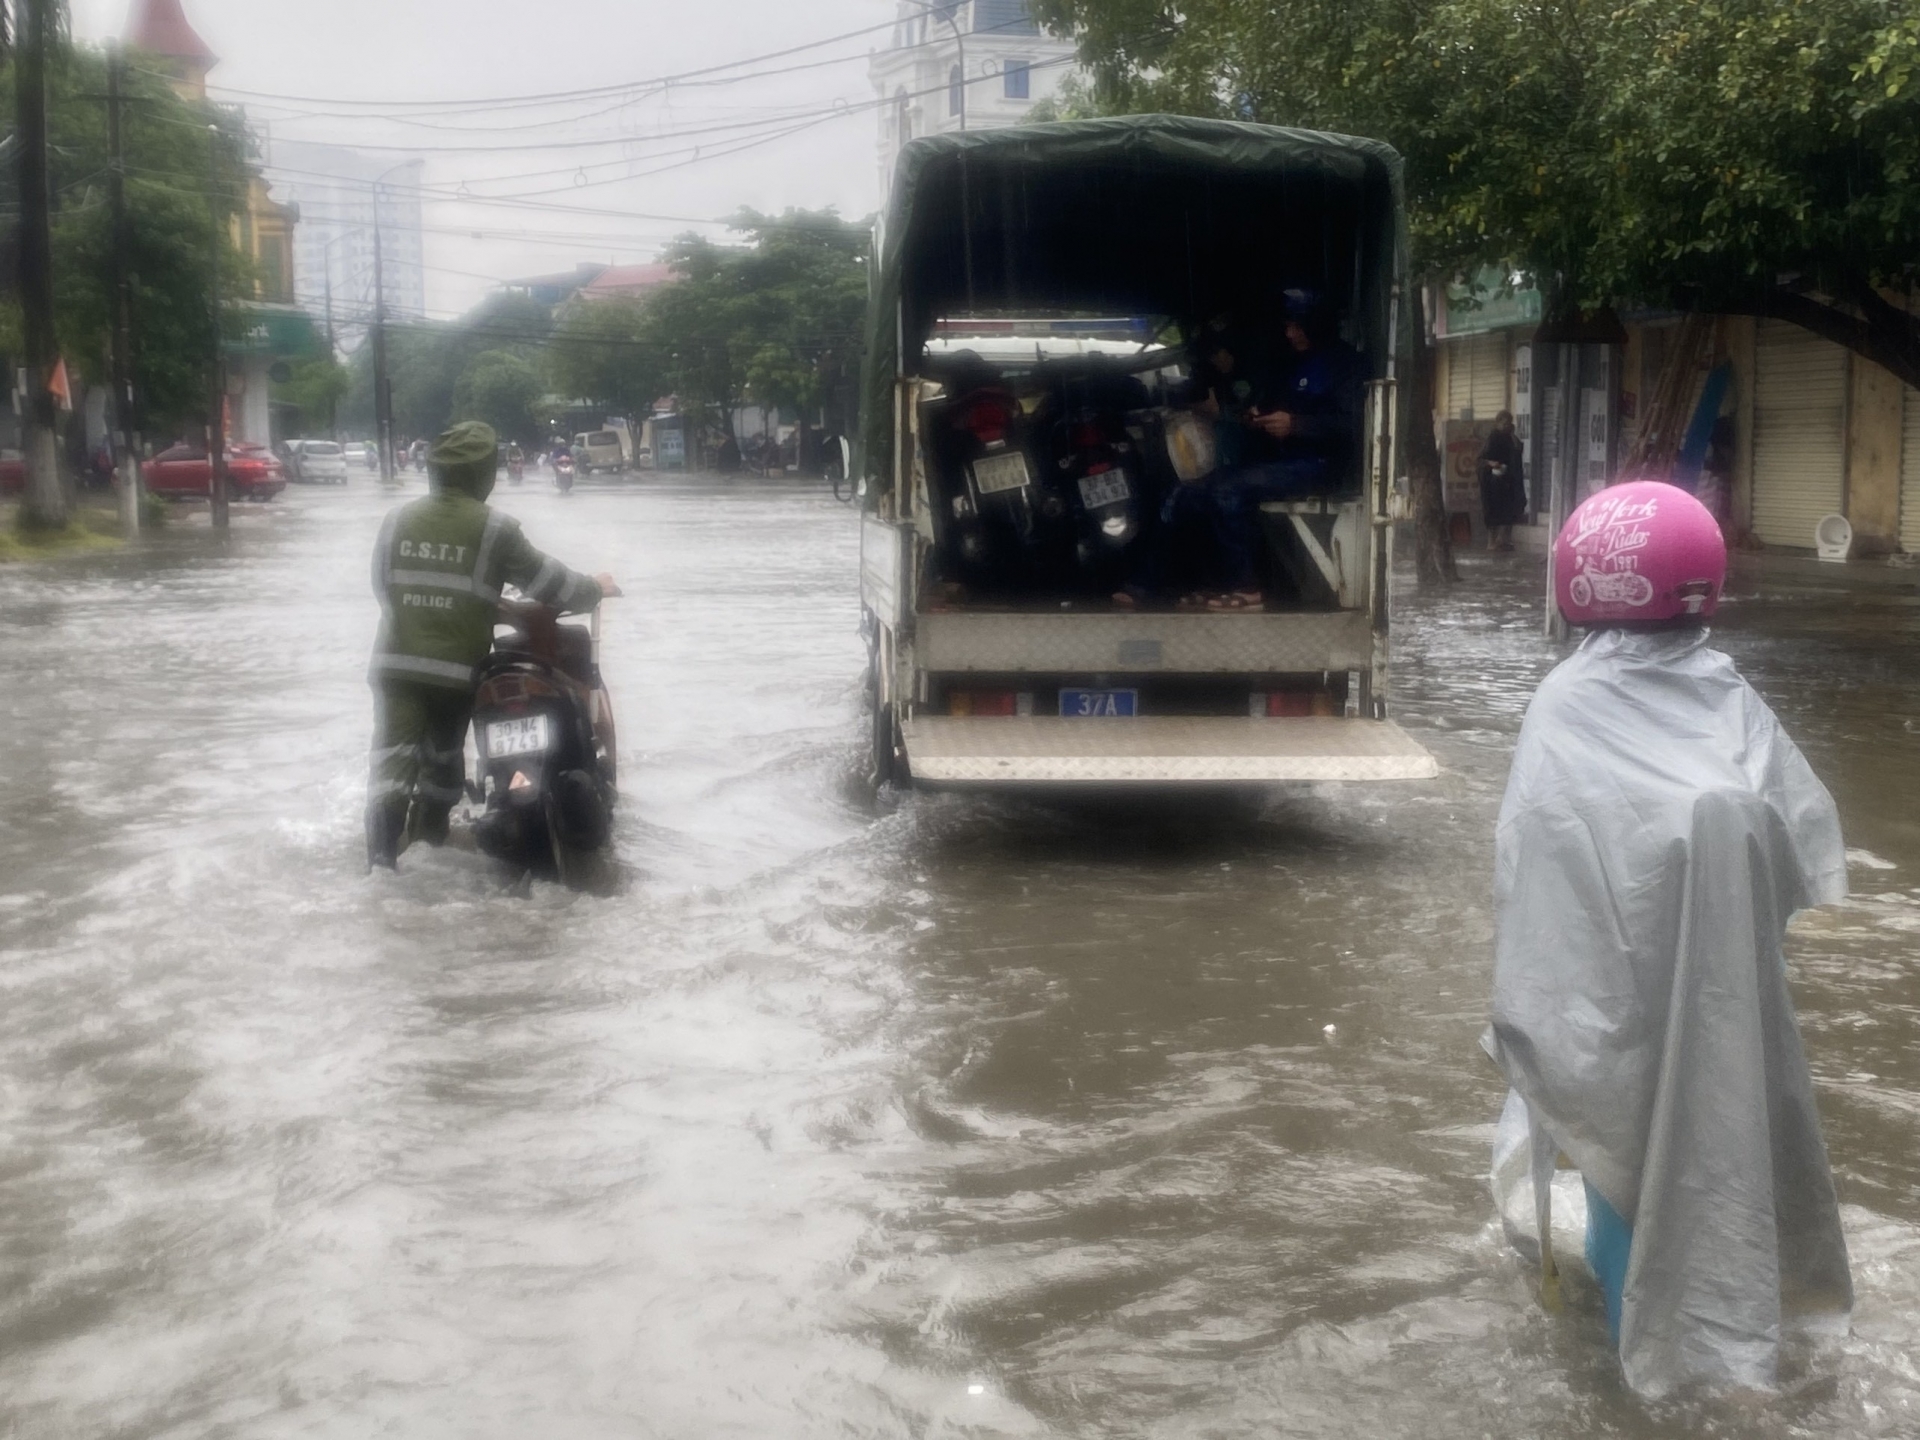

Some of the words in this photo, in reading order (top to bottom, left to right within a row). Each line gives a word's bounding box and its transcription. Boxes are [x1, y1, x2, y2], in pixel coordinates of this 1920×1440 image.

[1566, 502, 1608, 548] New
[1601, 496, 1658, 532] York
[400, 539, 466, 563] C.S.T.T
[1600, 524, 1651, 560] Rider
[402, 593, 454, 610] POLICE
[1078, 693, 1118, 716] 37A
[495, 734, 539, 756] 8749
